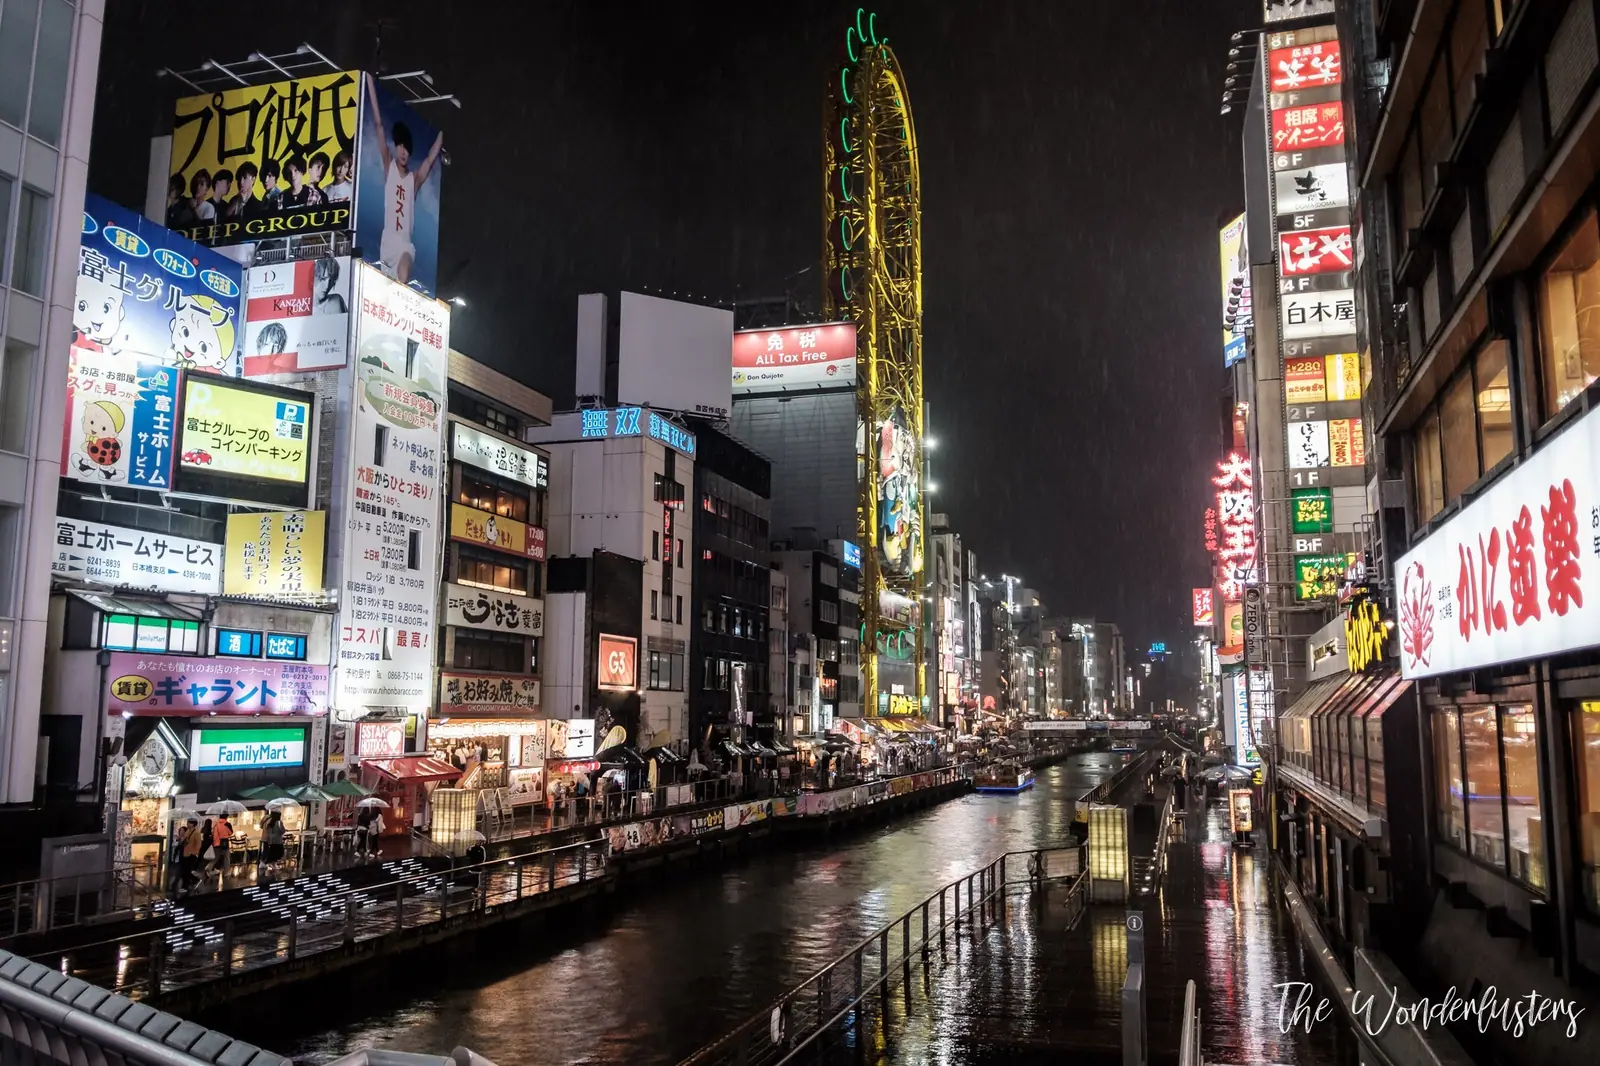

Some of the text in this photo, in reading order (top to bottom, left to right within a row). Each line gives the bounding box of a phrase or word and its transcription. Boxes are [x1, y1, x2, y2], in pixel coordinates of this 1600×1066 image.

[174, 73, 357, 174] プロ彼氏
[1284, 108, 1318, 127] 相席
[395, 184, 406, 232] ホスト
[245, 209, 349, 234] GROUP
[1294, 214, 1314, 228] 5F
[115, 229, 139, 254] 賃貸
[162, 251, 188, 276] リフォーム
[80, 246, 234, 328] 富士グループ
[273, 297, 311, 312] KANZAKI
[286, 304, 310, 317] RUKA
[1287, 299, 1356, 325] 白木屋
[755, 350, 828, 366] ALL Tax Free
[747, 371, 784, 381] Don Quijote
[581, 407, 641, 437] 無双
[1290, 406, 1316, 420] 2F
[149, 394, 171, 487] 富士ホーム
[187, 416, 270, 443] 富士グループの
[135, 431, 146, 480] サービス
[210, 437, 303, 463] コインパーキング
[457, 434, 493, 459] しゃぶしゃぶ
[1294, 471, 1319, 486] 1F
[56, 521, 214, 567] 富士ホームサービス
[1296, 538, 1322, 552] B1F
[58, 552, 121, 568] 店 6241-8839
[1456, 478, 1584, 643] かに道楽
[462, 592, 521, 629] うなぎ
[1246, 604, 1258, 632] ZERO
[228, 634, 241, 653] 酒
[268, 637, 295, 655] たばこ
[343, 626, 381, 645] コスパ
[608, 650, 626, 675] G3
[117, 680, 149, 696] 賃貸
[154, 675, 278, 707] ギャラント
[463, 678, 513, 703] お好み焼
[467, 704, 511, 712] OKONOMIYAKI
[361, 725, 387, 738] 5STAR
[218, 744, 288, 763] FamilyMart
[361, 738, 388, 753] HOTDOG
